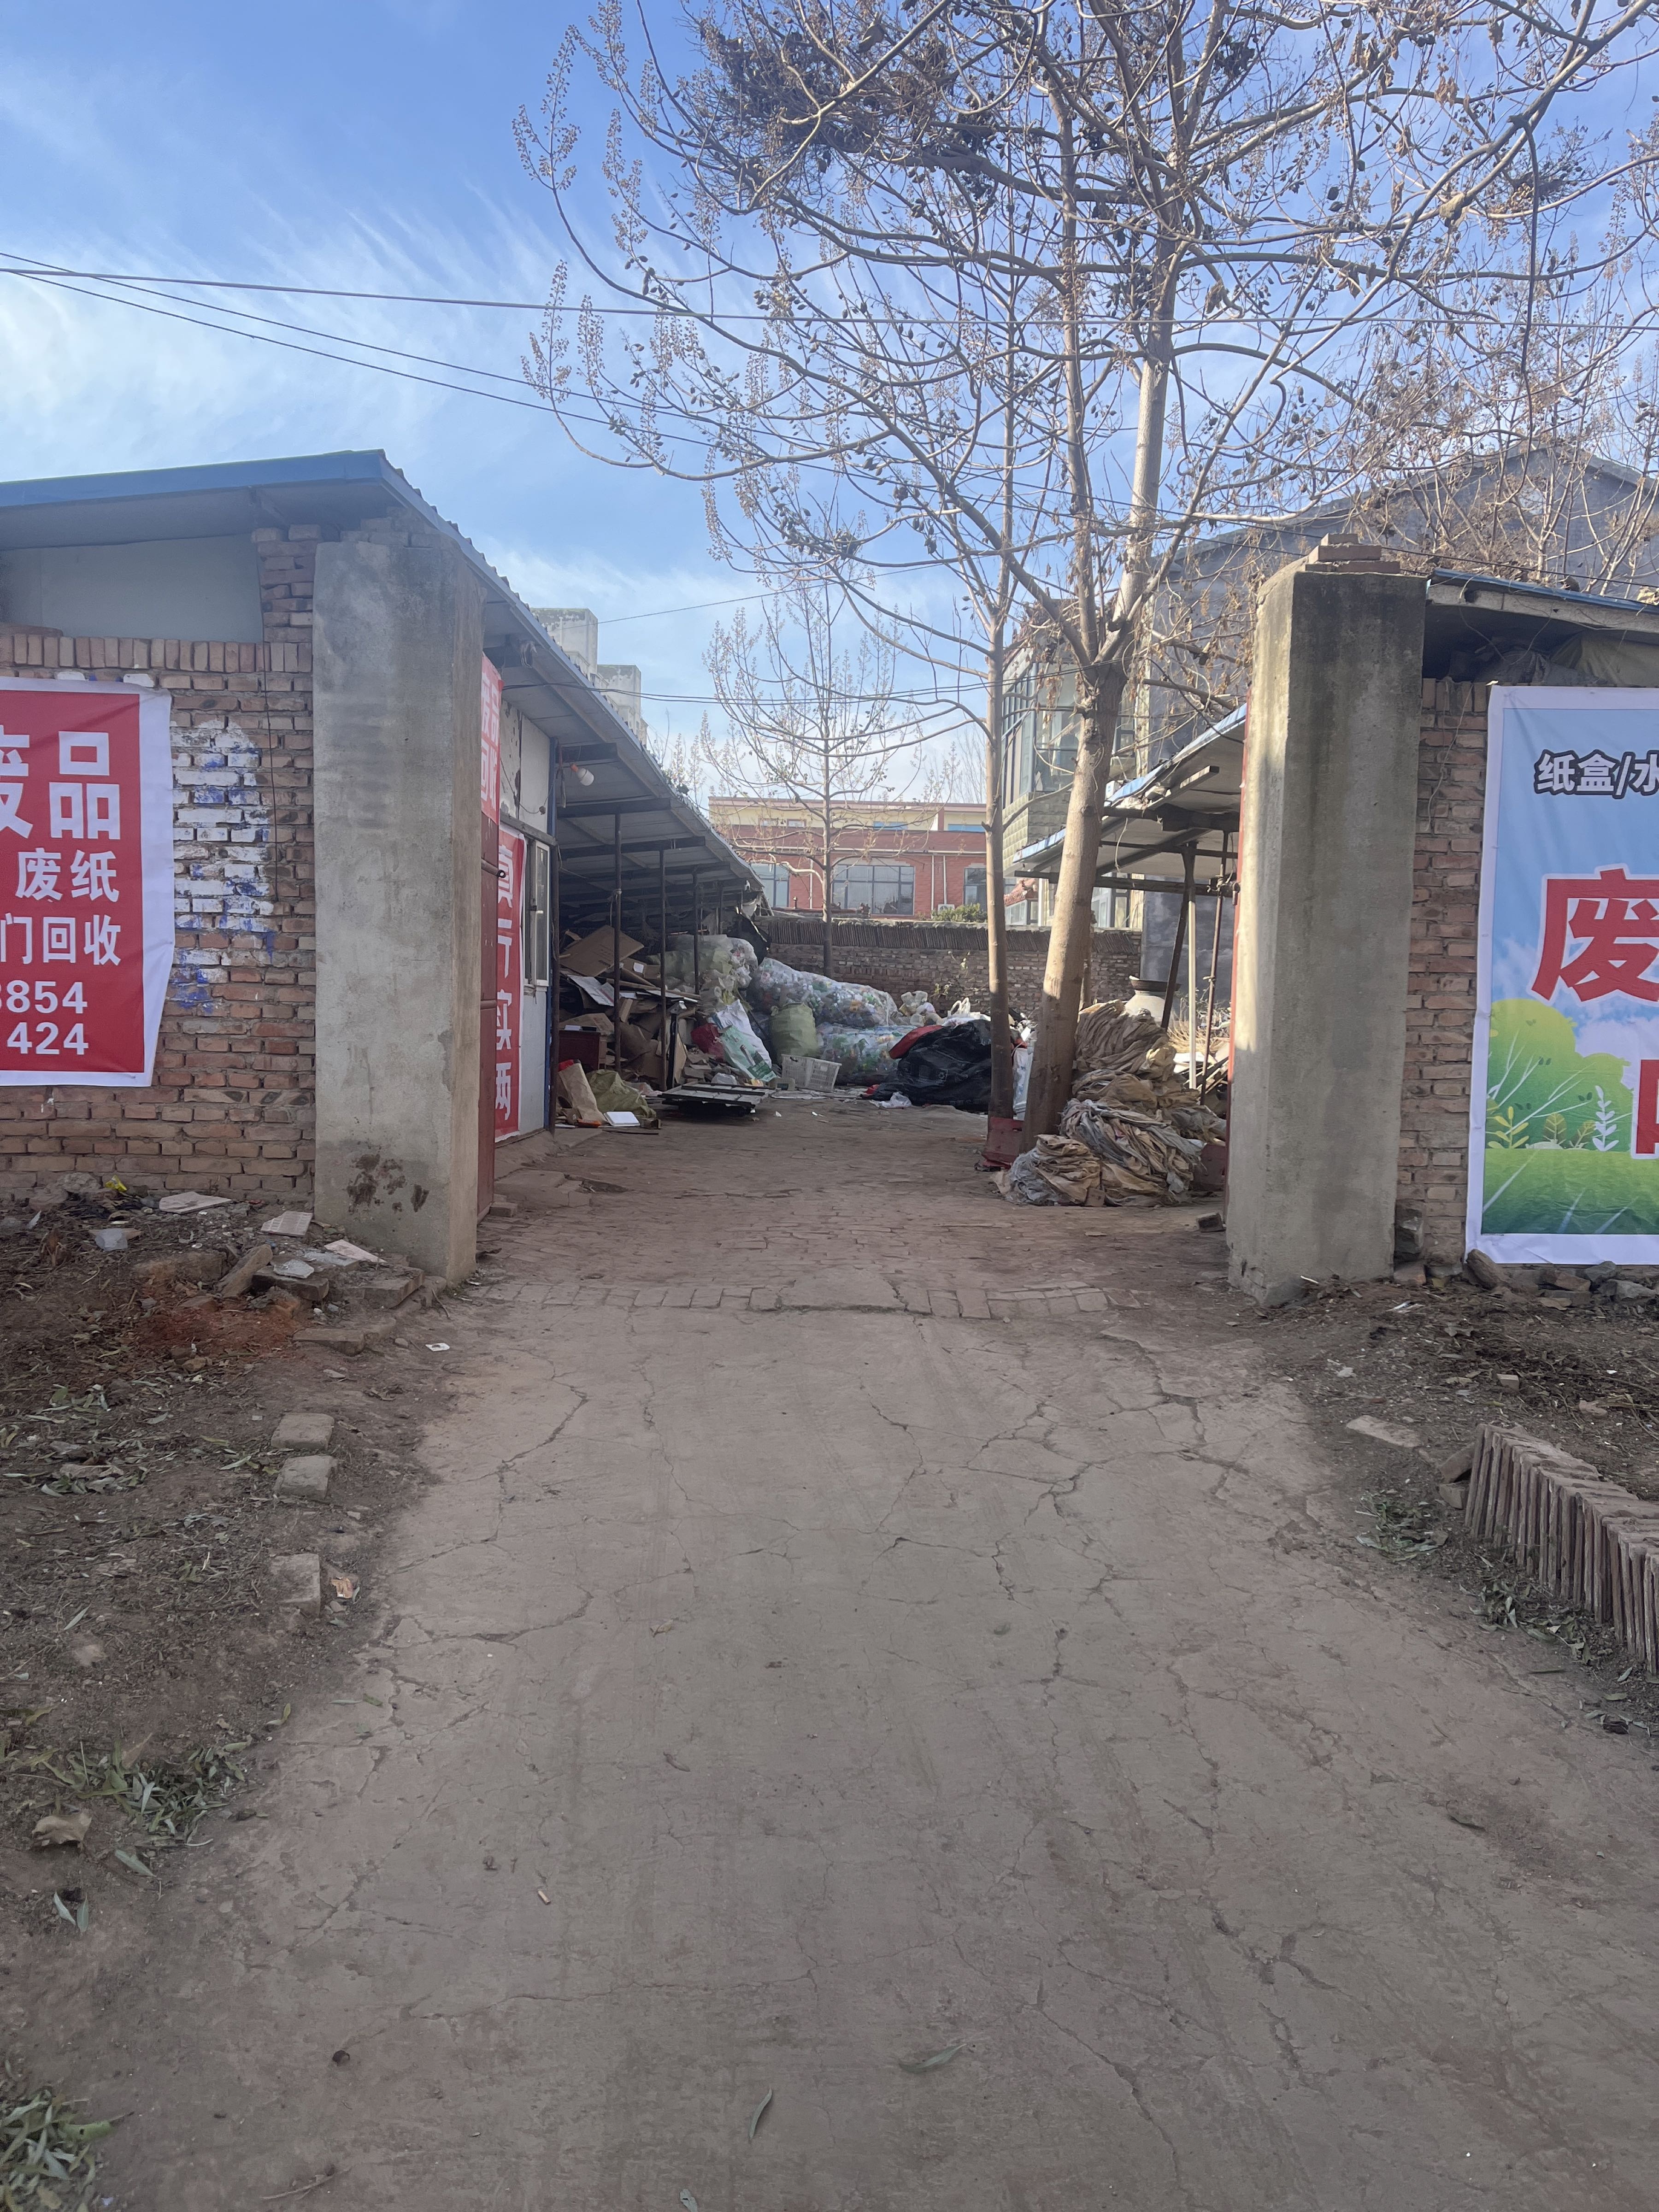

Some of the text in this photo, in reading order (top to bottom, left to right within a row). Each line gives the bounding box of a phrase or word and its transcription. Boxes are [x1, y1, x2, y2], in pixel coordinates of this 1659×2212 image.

[15, 847, 119, 902] 废纸
[0, 912, 121, 965] 门回收
[1530, 868, 1659, 1002] 废
[0, 980, 88, 1014] 854
[7, 1022, 88, 1055] 424
